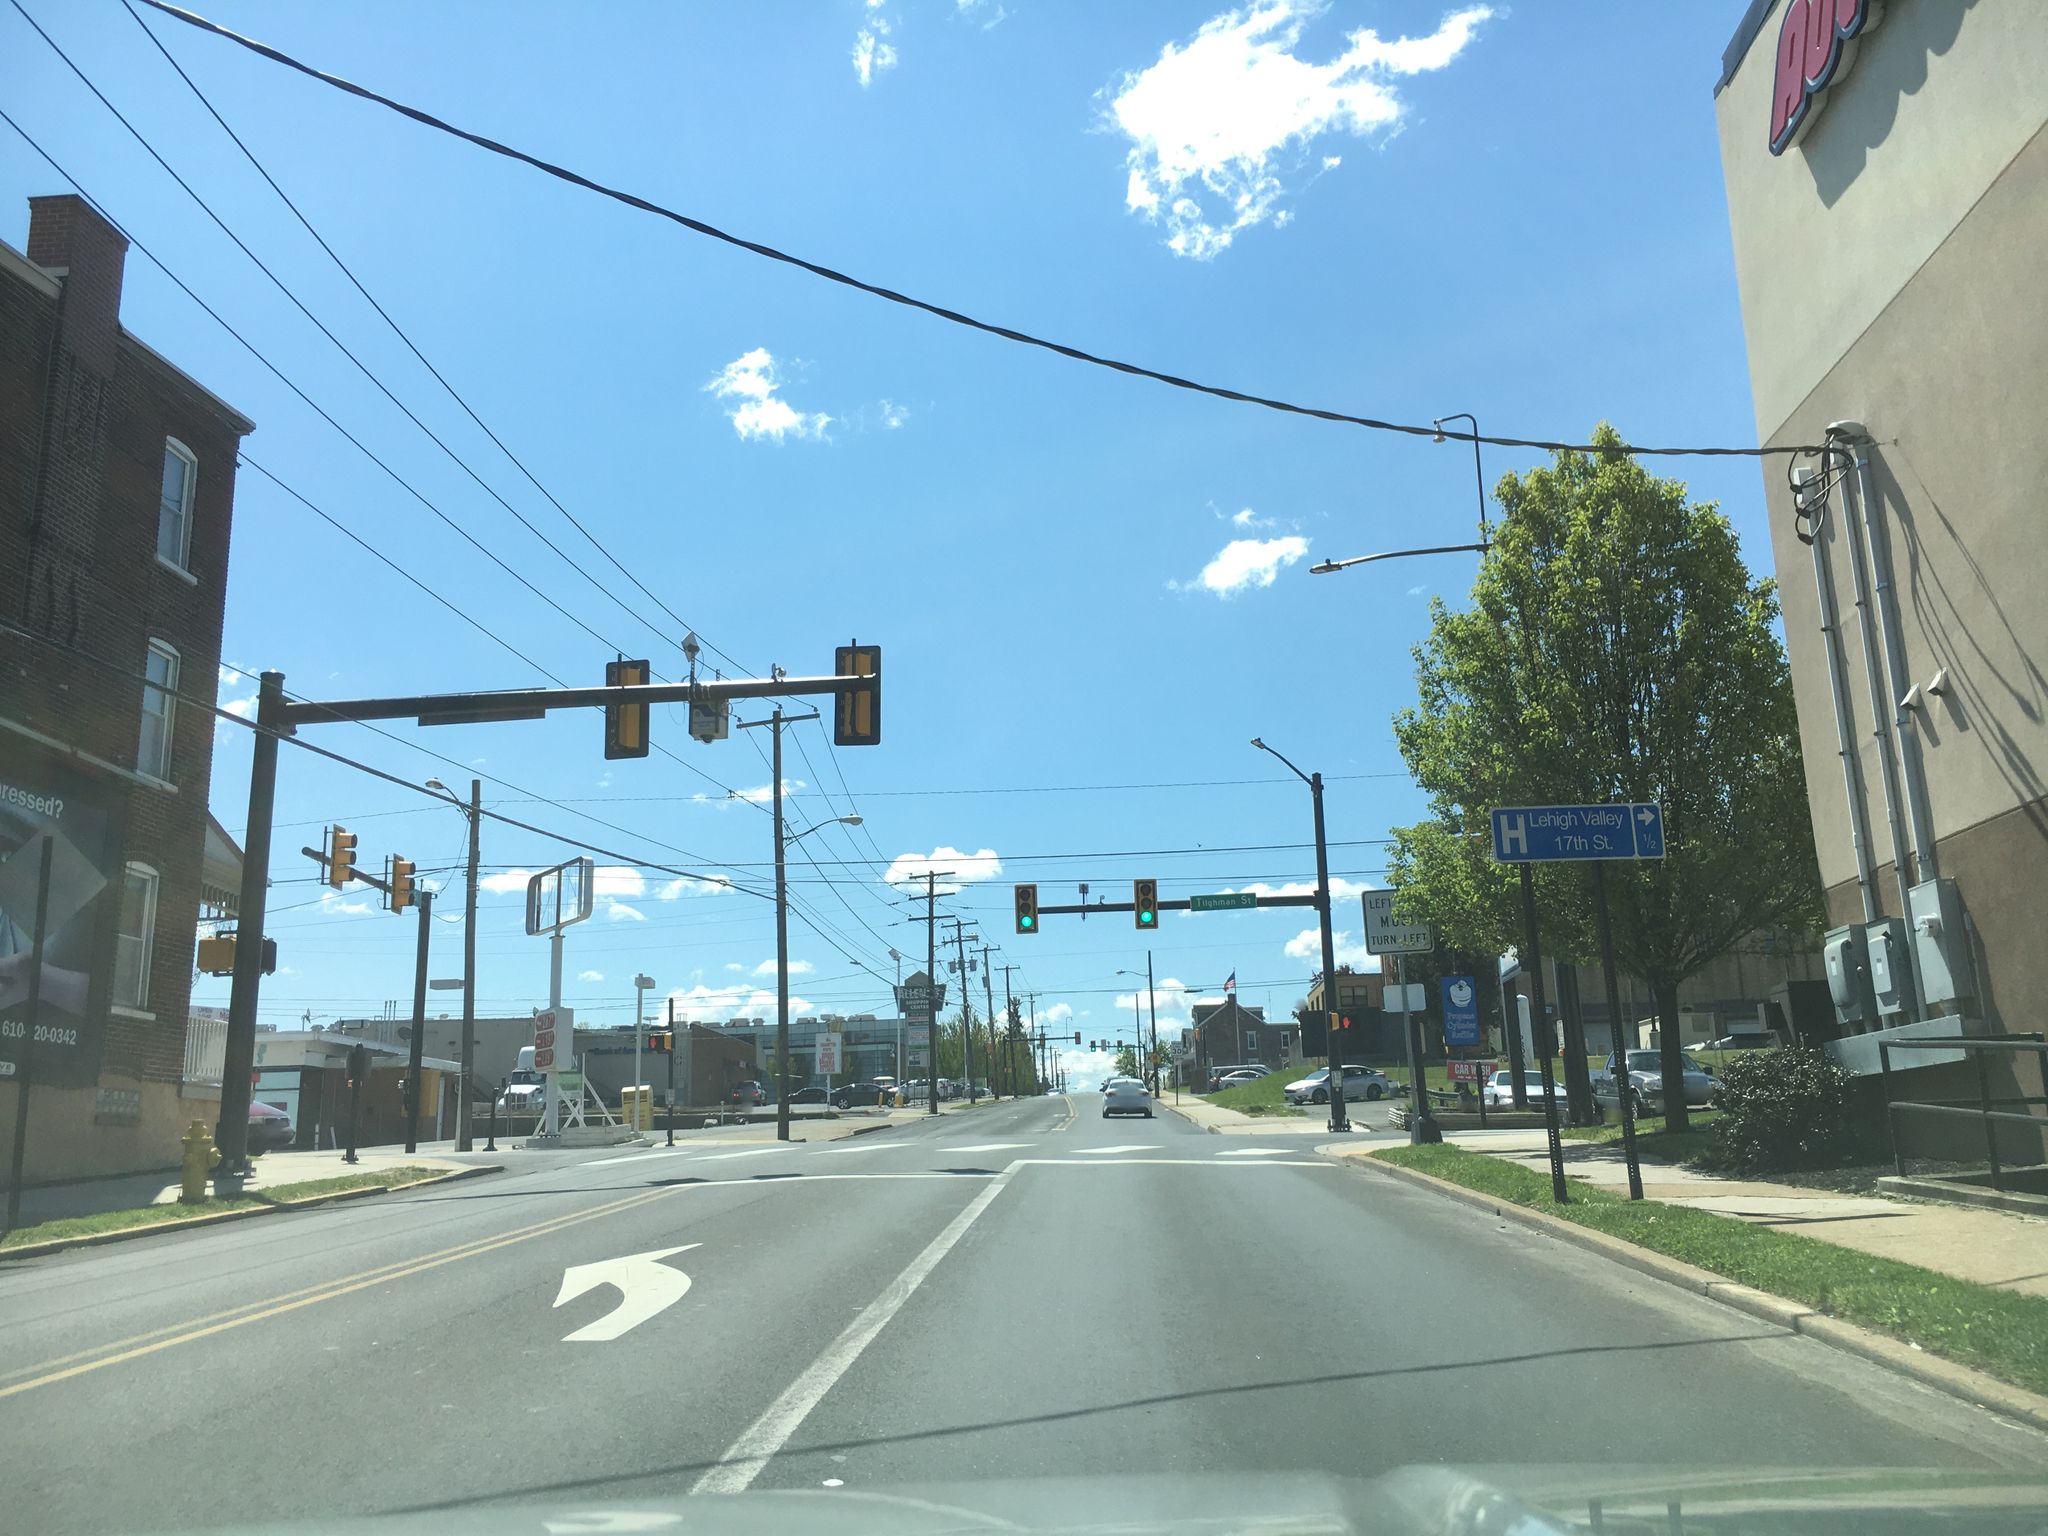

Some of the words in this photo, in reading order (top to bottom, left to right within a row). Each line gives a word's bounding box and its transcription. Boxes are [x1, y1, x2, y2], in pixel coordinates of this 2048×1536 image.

[0, 783, 64, 819] ressed?
[1529, 812, 1578, 829] Lehigh
[1580, 811, 1623, 829] Valley
[1554, 836, 1588, 851] 17th
[1593, 834, 1614, 850] St.
[1196, 897, 1236, 908] Tilghman
[1240, 895, 1251, 905] St
[1371, 935, 1397, 946] TURN
[2, 1020, 77, 1046] 610-20-0342
[1454, 1063, 1469, 1075] CAR
[1470, 1064, 1490, 1076] WSH
